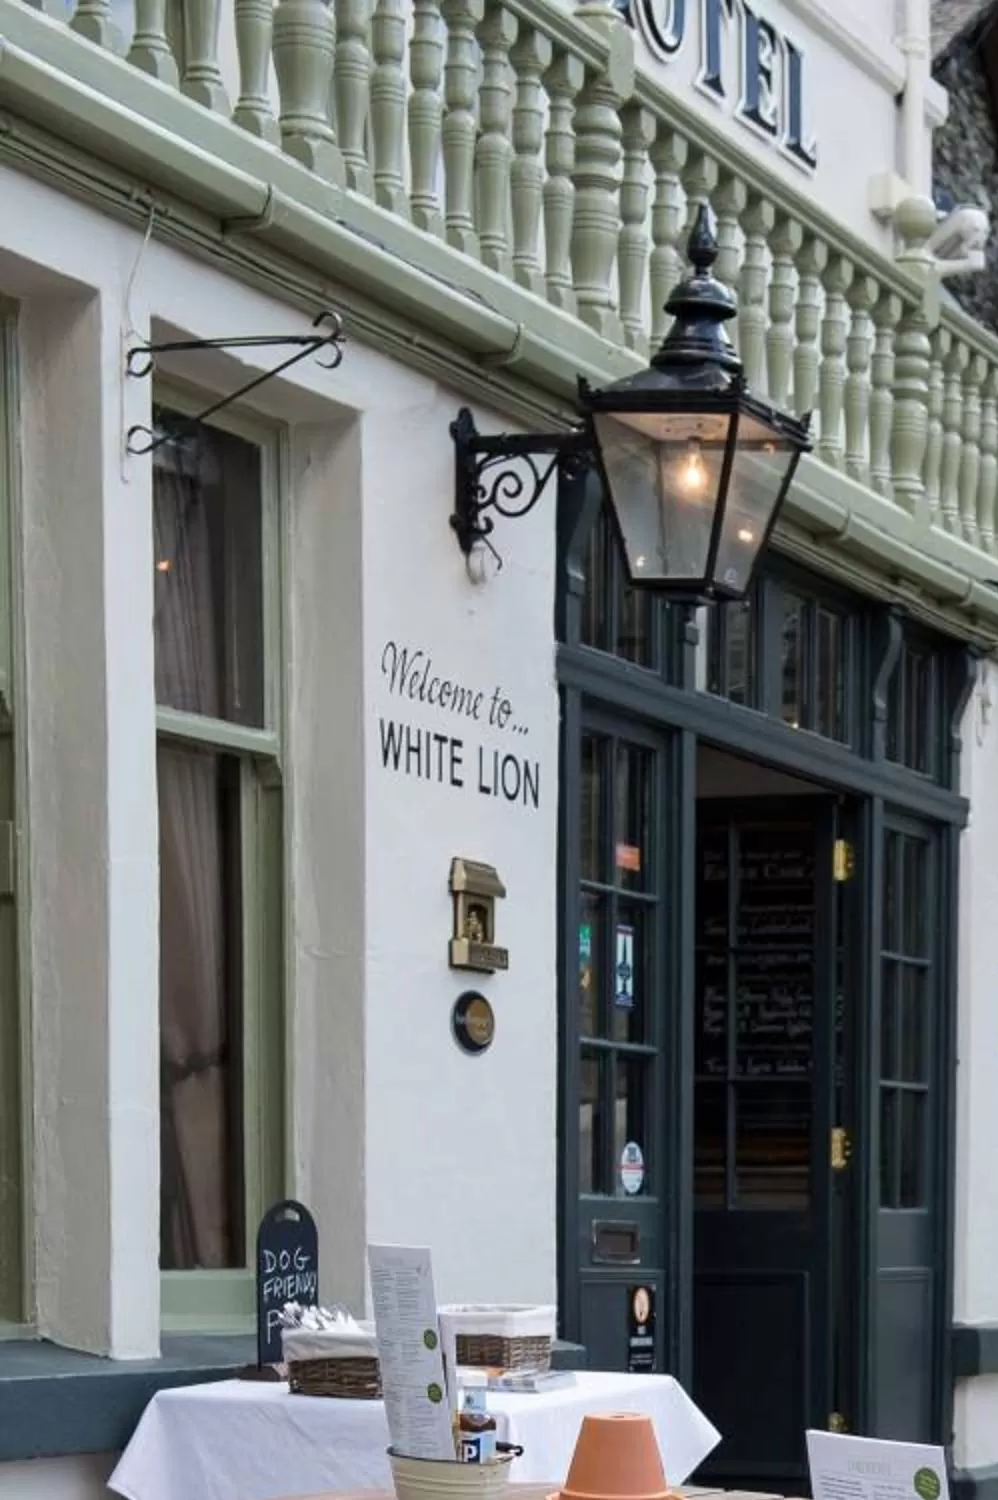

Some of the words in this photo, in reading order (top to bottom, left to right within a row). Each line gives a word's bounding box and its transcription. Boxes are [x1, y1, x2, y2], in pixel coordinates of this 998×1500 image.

[381, 641, 484, 720] Welcome
[379, 717, 464, 788] WHITE
[478, 745, 540, 809] LION
[263, 1246, 311, 1274] DOG
